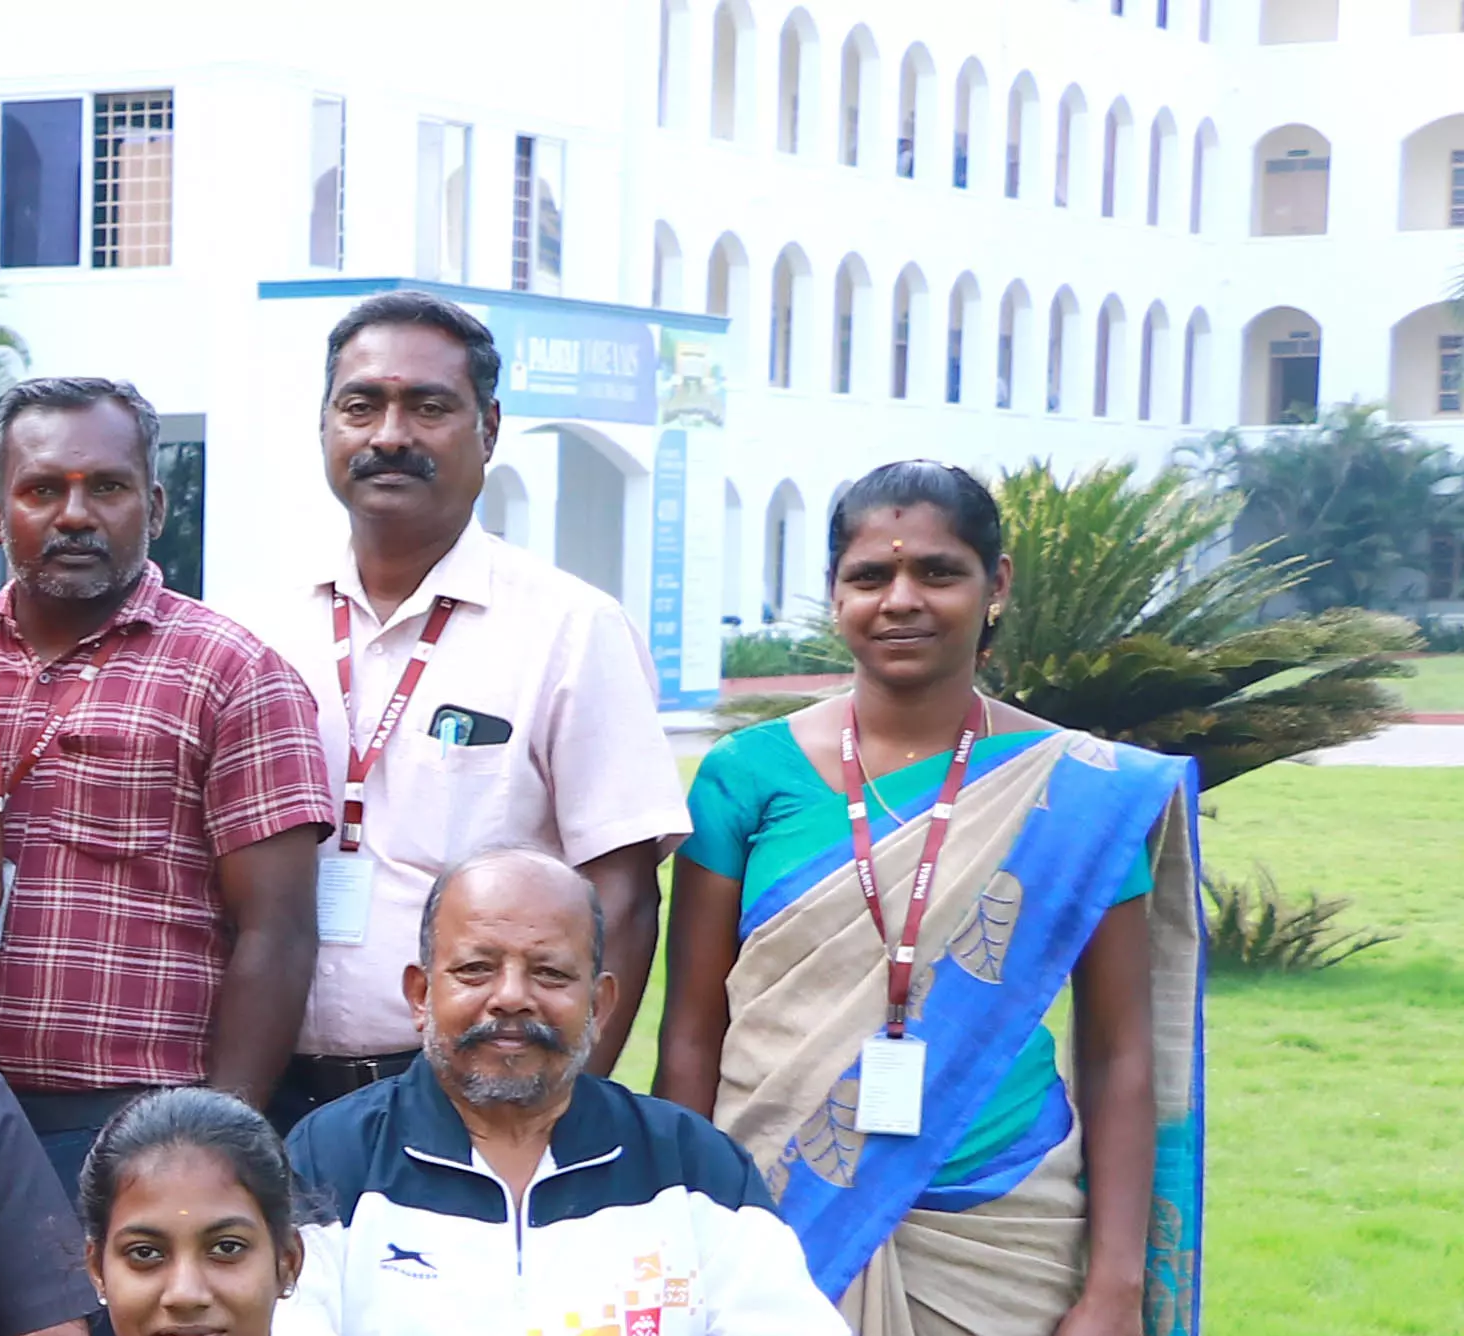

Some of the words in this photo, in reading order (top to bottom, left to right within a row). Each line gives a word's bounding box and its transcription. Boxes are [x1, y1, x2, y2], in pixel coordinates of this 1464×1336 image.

[31, 715, 64, 758] PAAVAI
[372, 693, 409, 750] PAAVAI
[954, 729, 976, 764] PAAVAI
[858, 859, 876, 898] PAAVAI
[913, 862, 934, 900] PAAVAI
